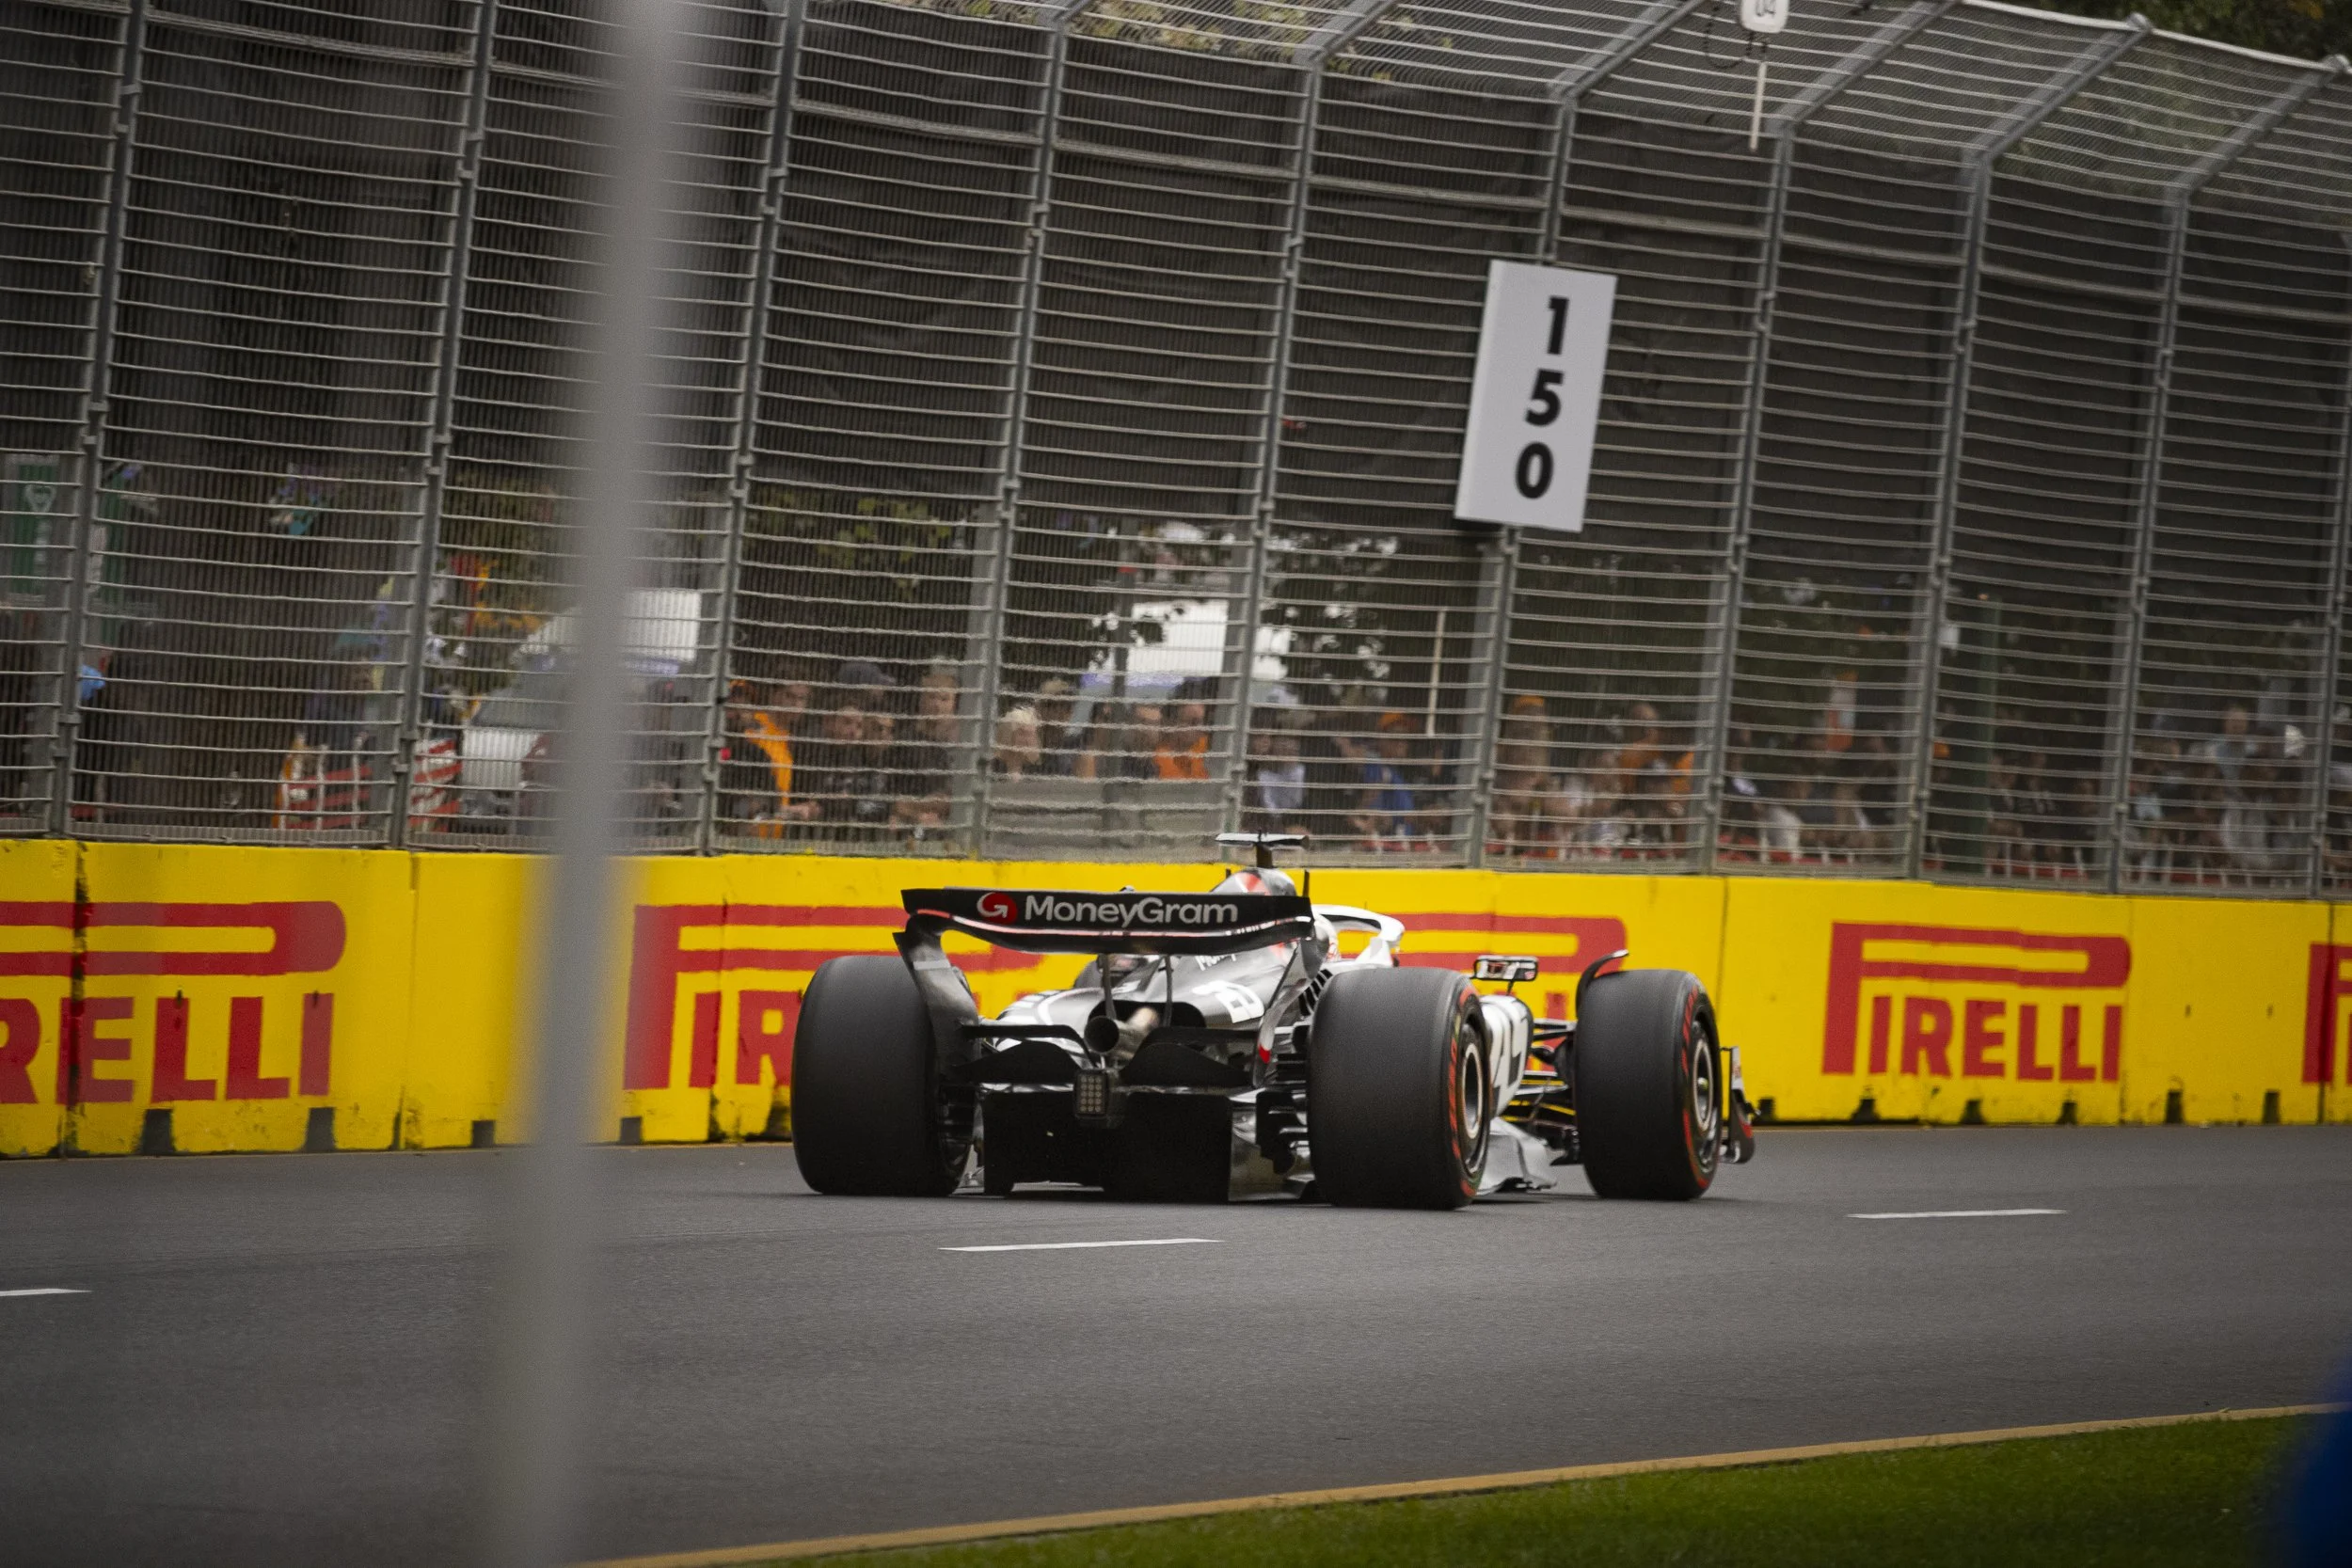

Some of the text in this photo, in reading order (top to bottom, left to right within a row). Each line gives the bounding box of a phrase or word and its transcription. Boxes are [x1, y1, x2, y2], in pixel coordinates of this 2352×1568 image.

[1517, 296, 1569, 499] 150
[1025, 895, 1239, 928] MoneyGram
[1823, 923, 2131, 1081] PIRELLI
